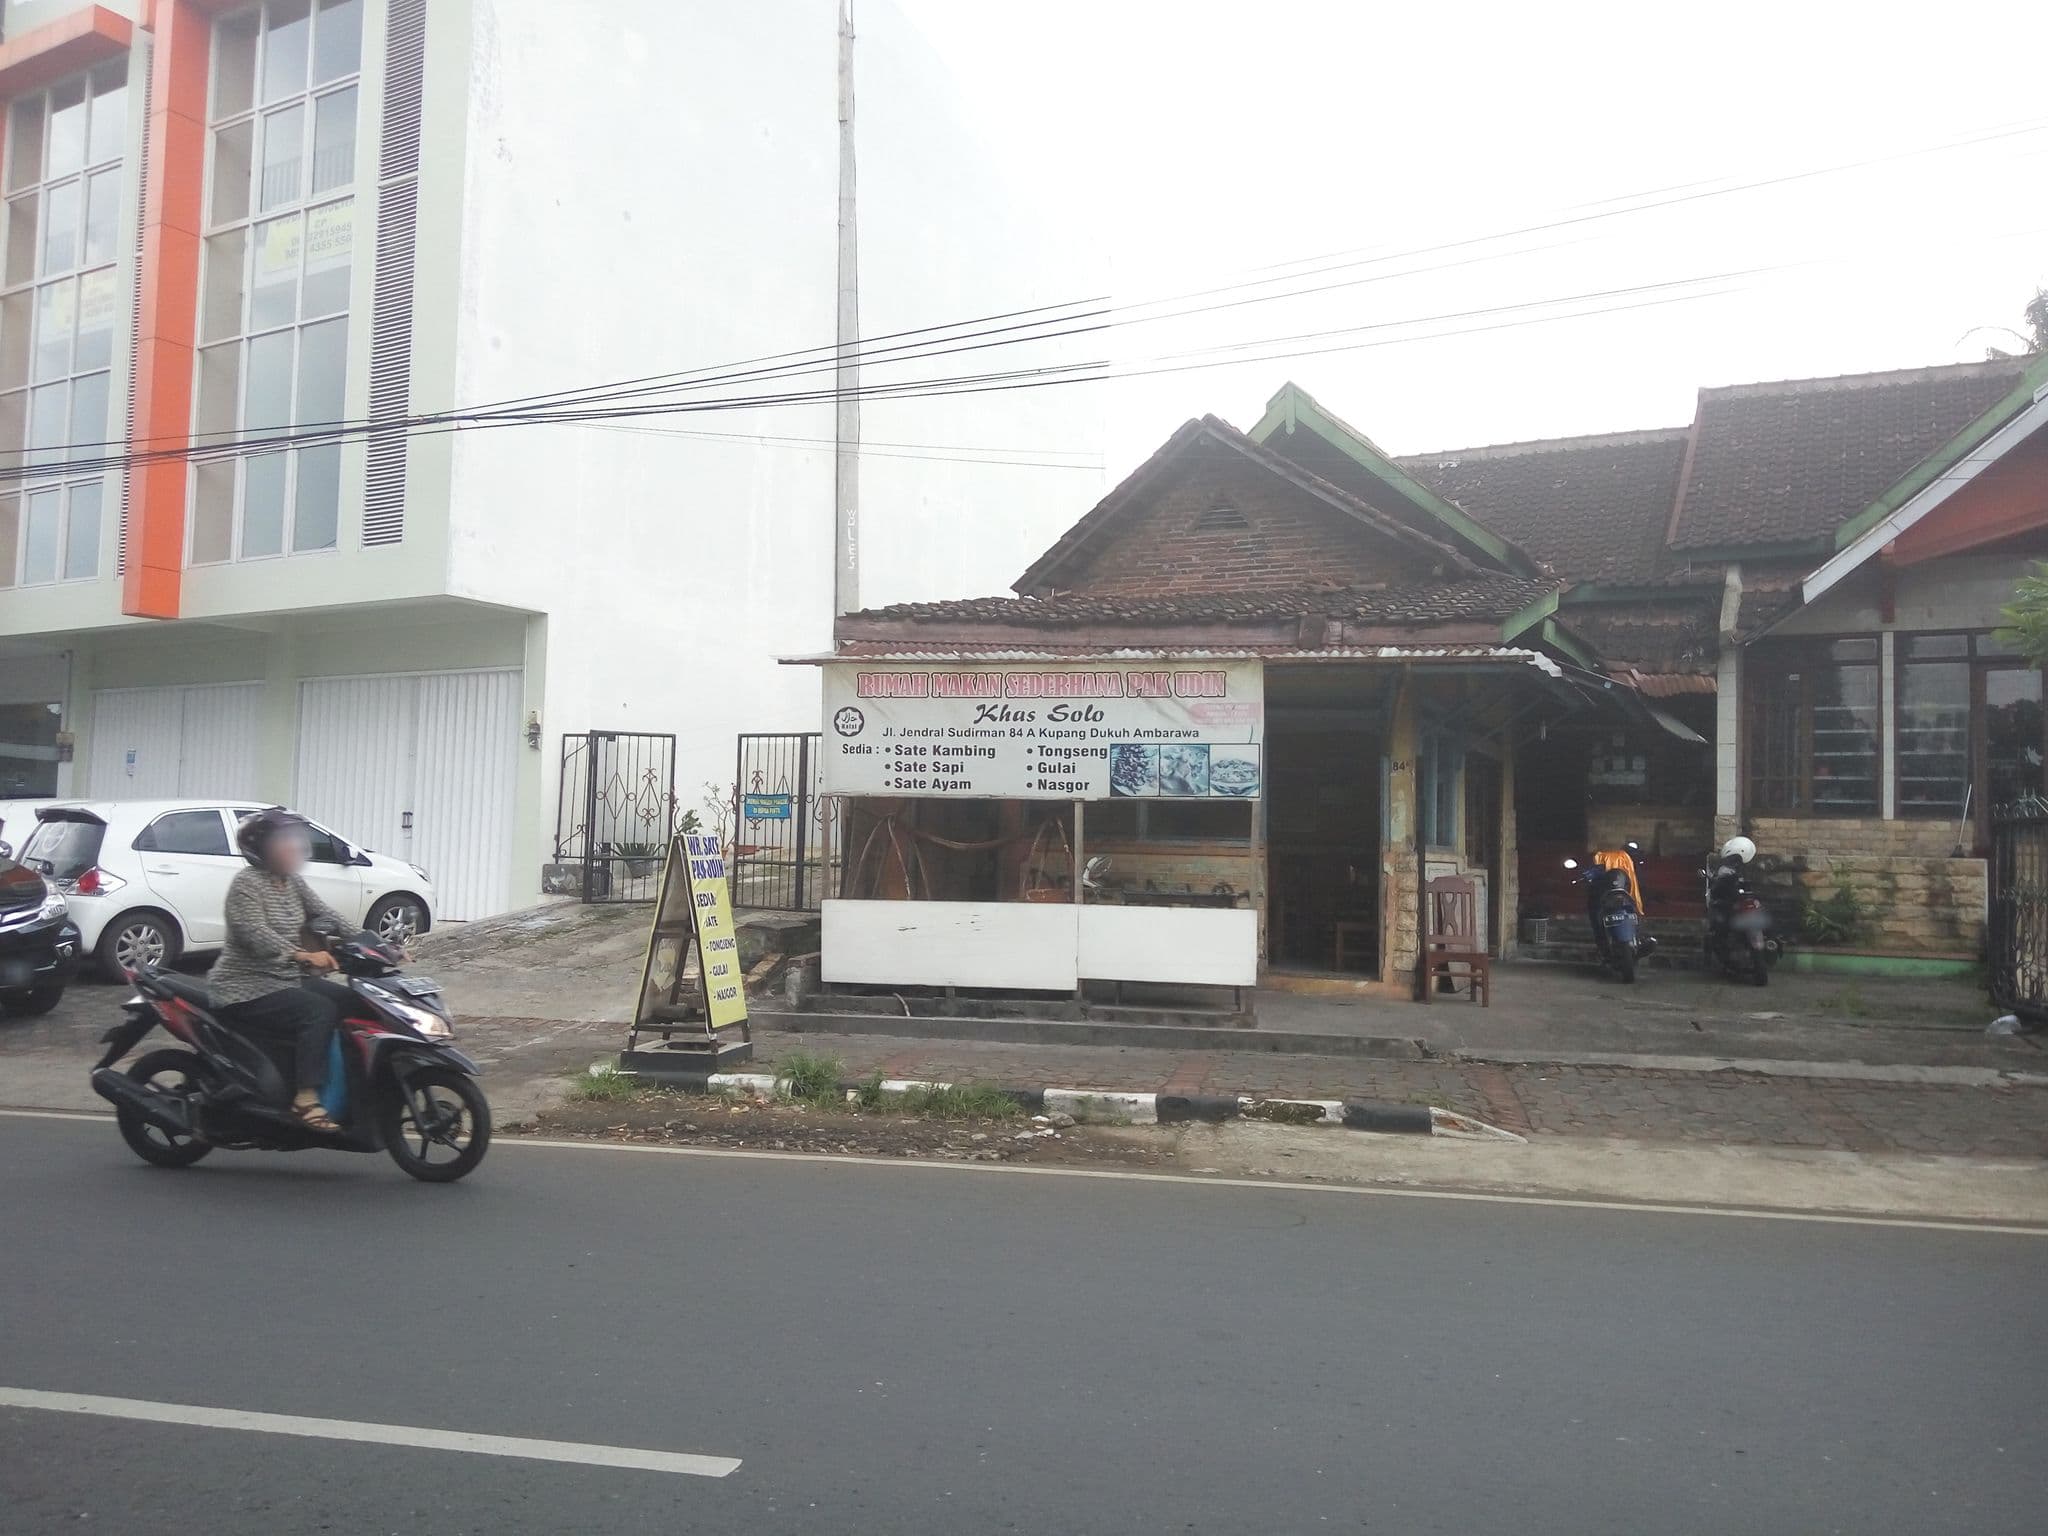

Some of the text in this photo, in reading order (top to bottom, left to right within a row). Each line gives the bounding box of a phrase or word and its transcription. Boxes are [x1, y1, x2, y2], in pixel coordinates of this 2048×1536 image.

[857, 672, 1226, 698] RUMAH MAKAN SEDERHANA PAK UDIN
[973, 703, 1104, 724] Khas Solo
[899, 727, 945, 738] Jendral
[948, 727, 1006, 738] Sudirman
[1009, 727, 1024, 739] 84
[1026, 727, 1036, 738] A
[1039, 728, 1087, 741] Kupang
[1090, 728, 1130, 738] Dukuh
[1133, 728, 1200, 739] Ambarawa
[842, 743, 873, 755] Sedia
[894, 744, 997, 759] Sate Kambing
[1037, 745, 1108, 759] Tongseng
[894, 760, 965, 775] Sate Sapi
[1037, 762, 1077, 774] Gulai
[894, 777, 972, 791] Sate Ayam
[1037, 779, 1090, 793] Nasgor
[703, 836, 721, 856] SATE
